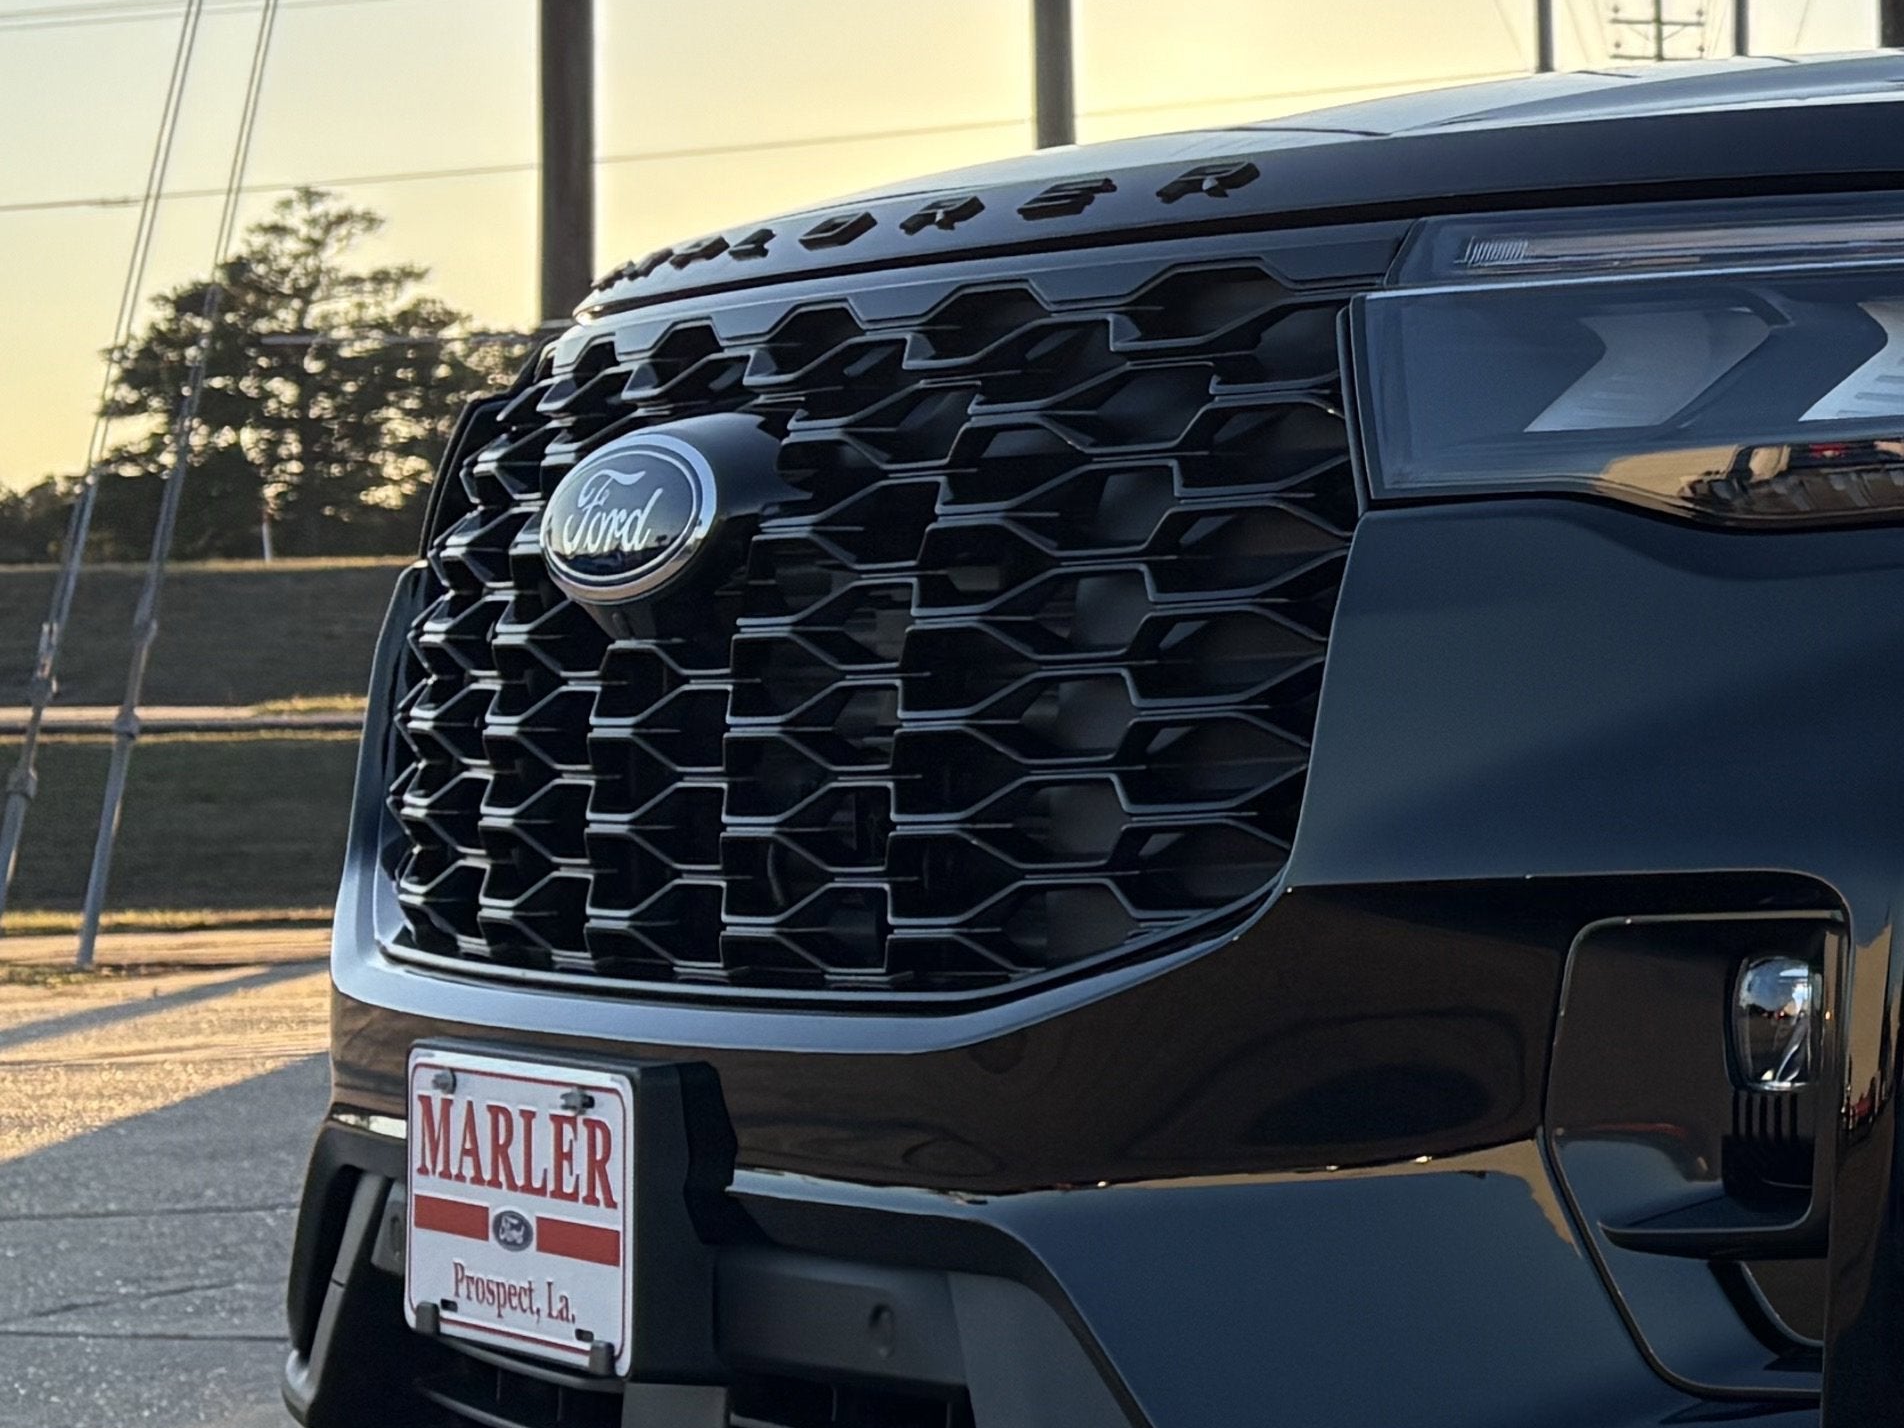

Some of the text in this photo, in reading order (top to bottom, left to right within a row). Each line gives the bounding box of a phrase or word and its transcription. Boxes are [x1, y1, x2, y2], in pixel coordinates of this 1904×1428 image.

[562, 468, 663, 558] Ford
[416, 1094, 618, 1209] MARLER
[453, 1261, 575, 1324] Prospect, La.
